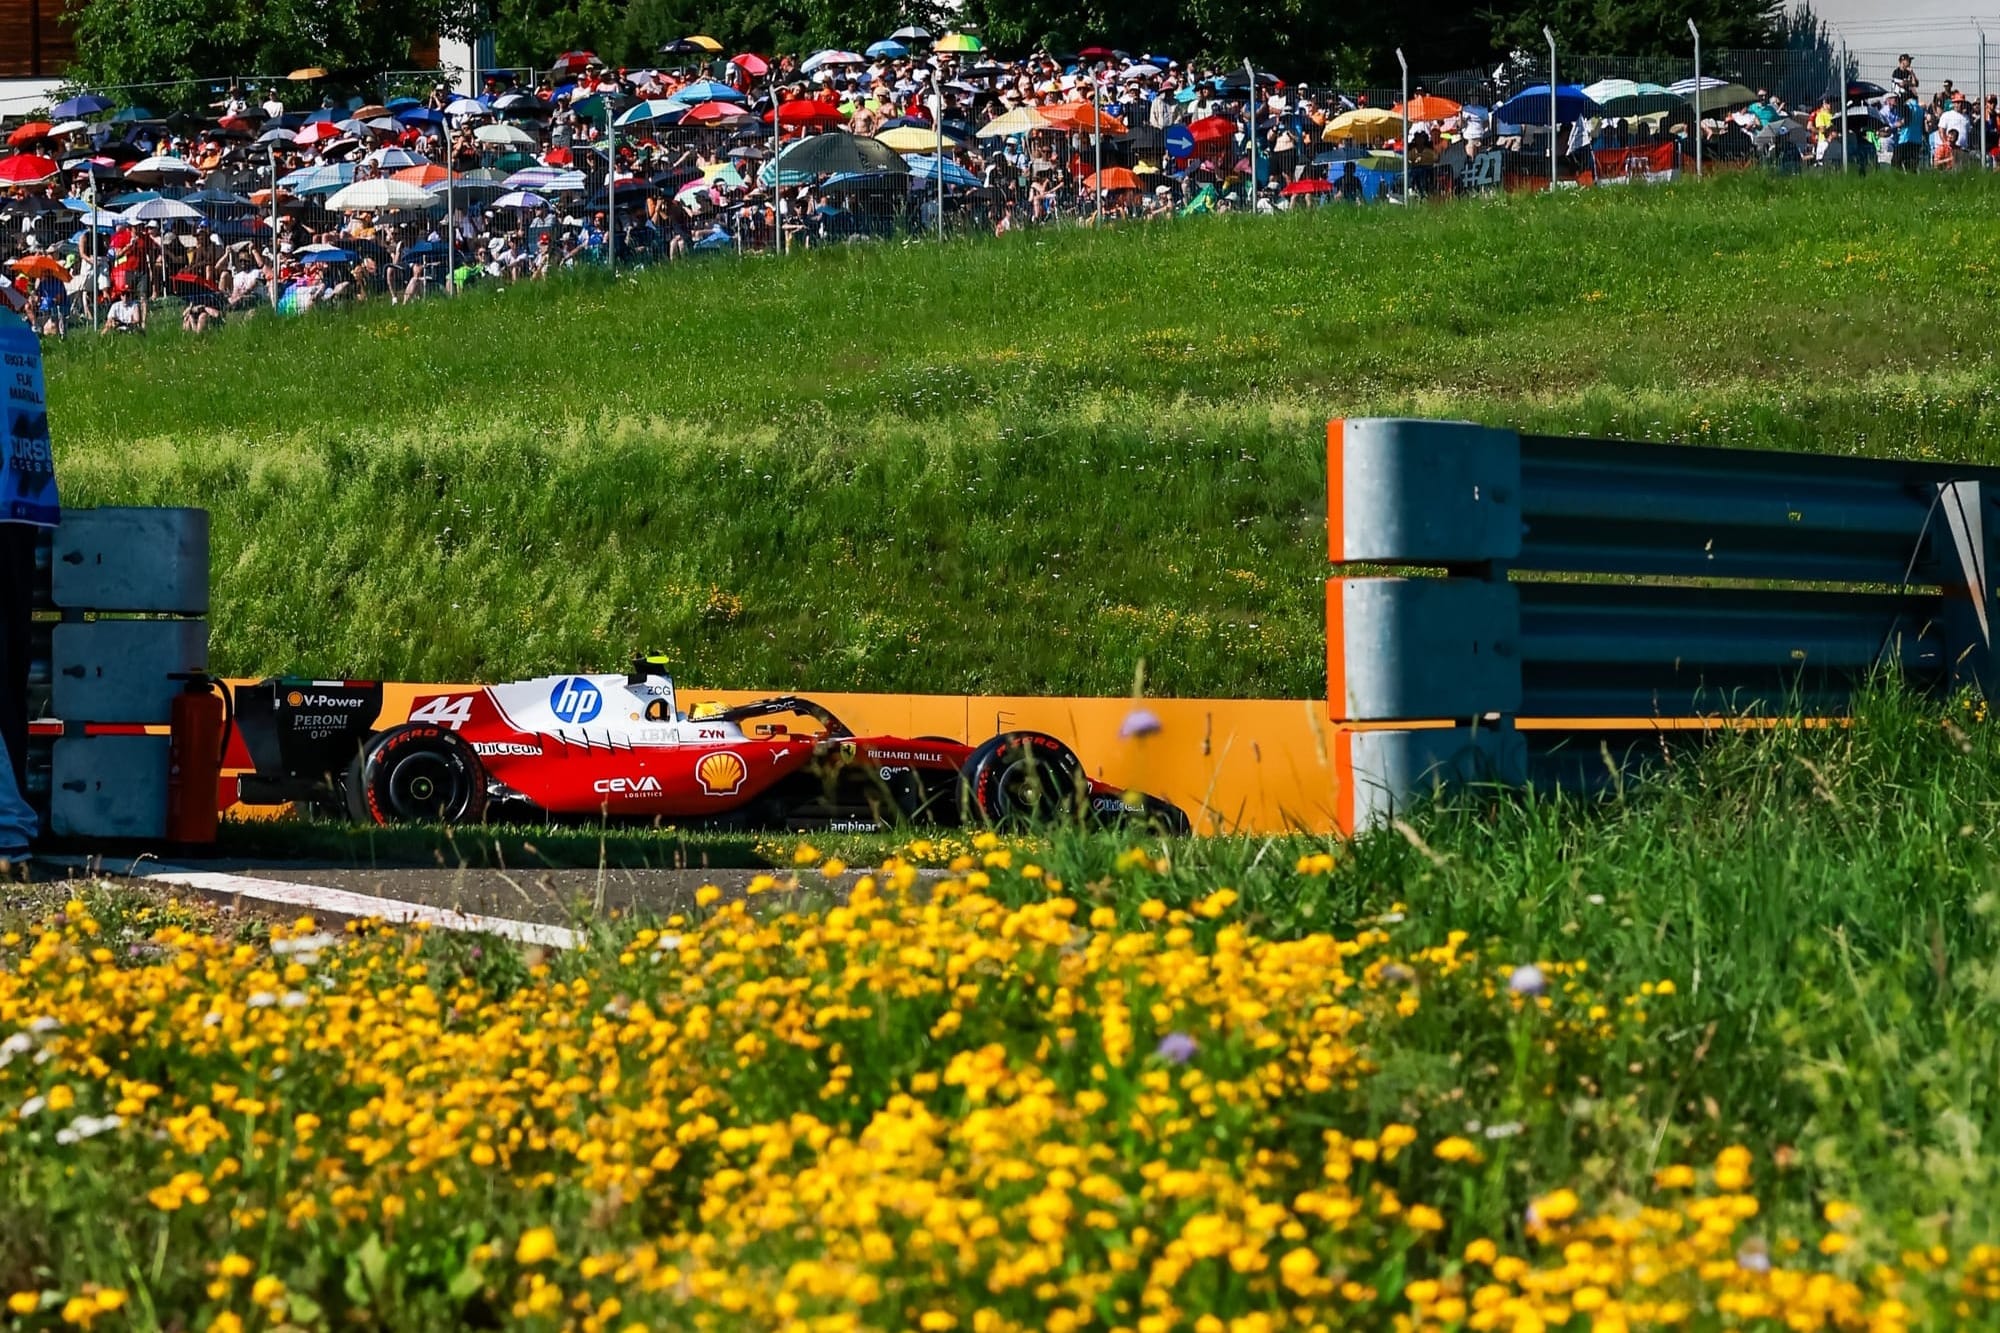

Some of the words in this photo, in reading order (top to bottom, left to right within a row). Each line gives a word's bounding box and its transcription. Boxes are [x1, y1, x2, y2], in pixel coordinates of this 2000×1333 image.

[647, 686, 671, 696] ZCG
[303, 695, 364, 708] V-Power
[554, 676, 599, 724] hp
[409, 696, 474, 731] 44
[293, 714, 349, 726] PERONI
[640, 728, 676, 742] IBM
[699, 729, 725, 739] ZYN
[867, 750, 911, 761] RICHARD
[913, 751, 944, 762] MILLE
